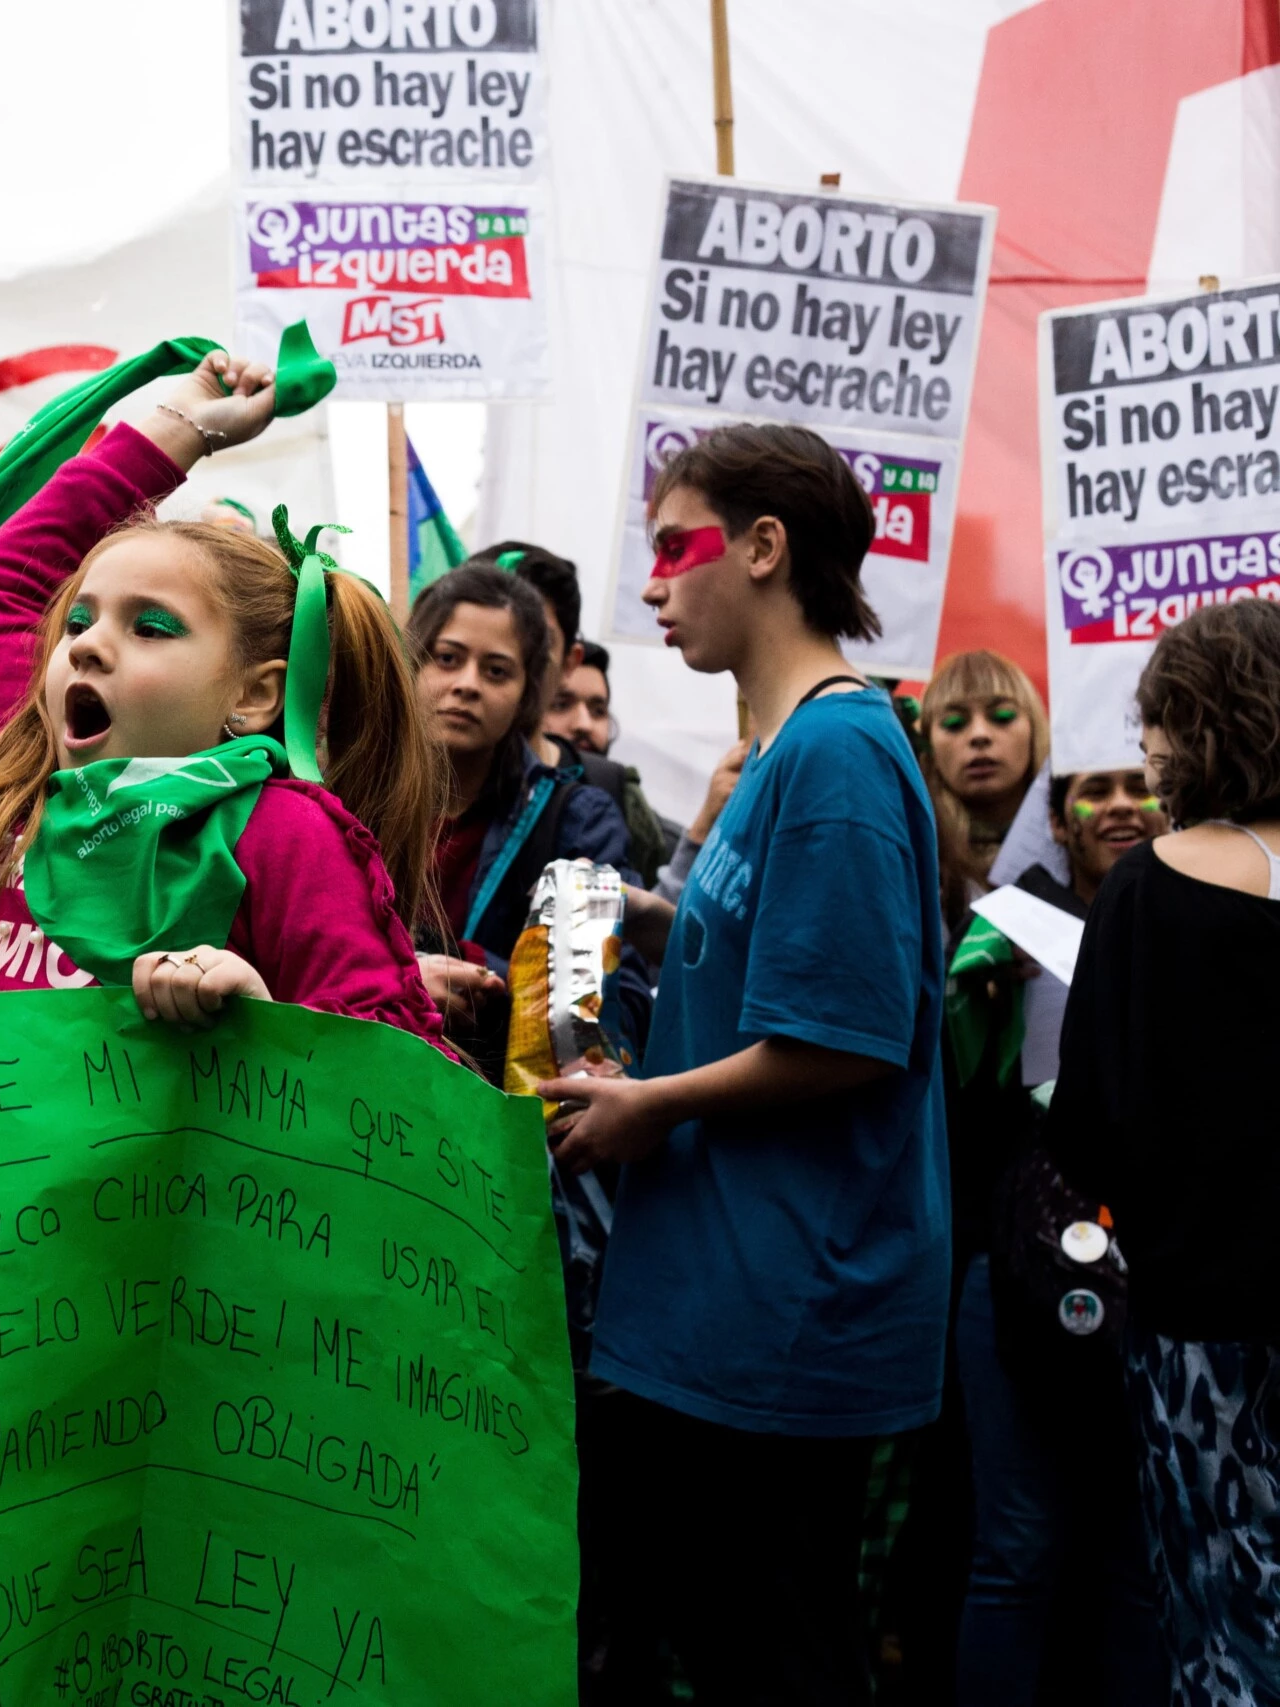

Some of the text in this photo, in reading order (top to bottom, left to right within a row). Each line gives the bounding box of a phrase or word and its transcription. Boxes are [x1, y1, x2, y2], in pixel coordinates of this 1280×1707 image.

[274, 0, 499, 51] ABORTO
[248, 59, 532, 119] Si no hay ley
[250, 116, 534, 179] hay escrache
[297, 241, 514, 291] izquierda
[697, 195, 936, 284] ABORTO
[348, 300, 440, 344] MST
[660, 268, 963, 366] Si no hay ley
[1089, 293, 1280, 385] ABORT
[371, 353, 482, 369] IZQUIERDA
[652, 329, 952, 422] hay escrache
[1063, 381, 1279, 452] Si no hay
[1066, 461, 1148, 523] hay
[76, 821, 120, 860] aborto
[117, 799, 153, 829] legal
[83, 1039, 141, 1106] MI
[188, 1045, 314, 1133] MAMÁ
[349, 1097, 414, 1181] QUE
[93, 1160, 207, 1222] CHICA
[228, 1173, 332, 1259] PARA
[381, 1237, 465, 1323] USAR
[475, 1286, 518, 1359] EL
[313, 1316, 371, 1391] ME
[395, 1328, 529, 1457] IMAGINES
[72, 1525, 149, 1603] SEA
[194, 1530, 296, 1663] LEY
[326, 1606, 386, 1698] YA
